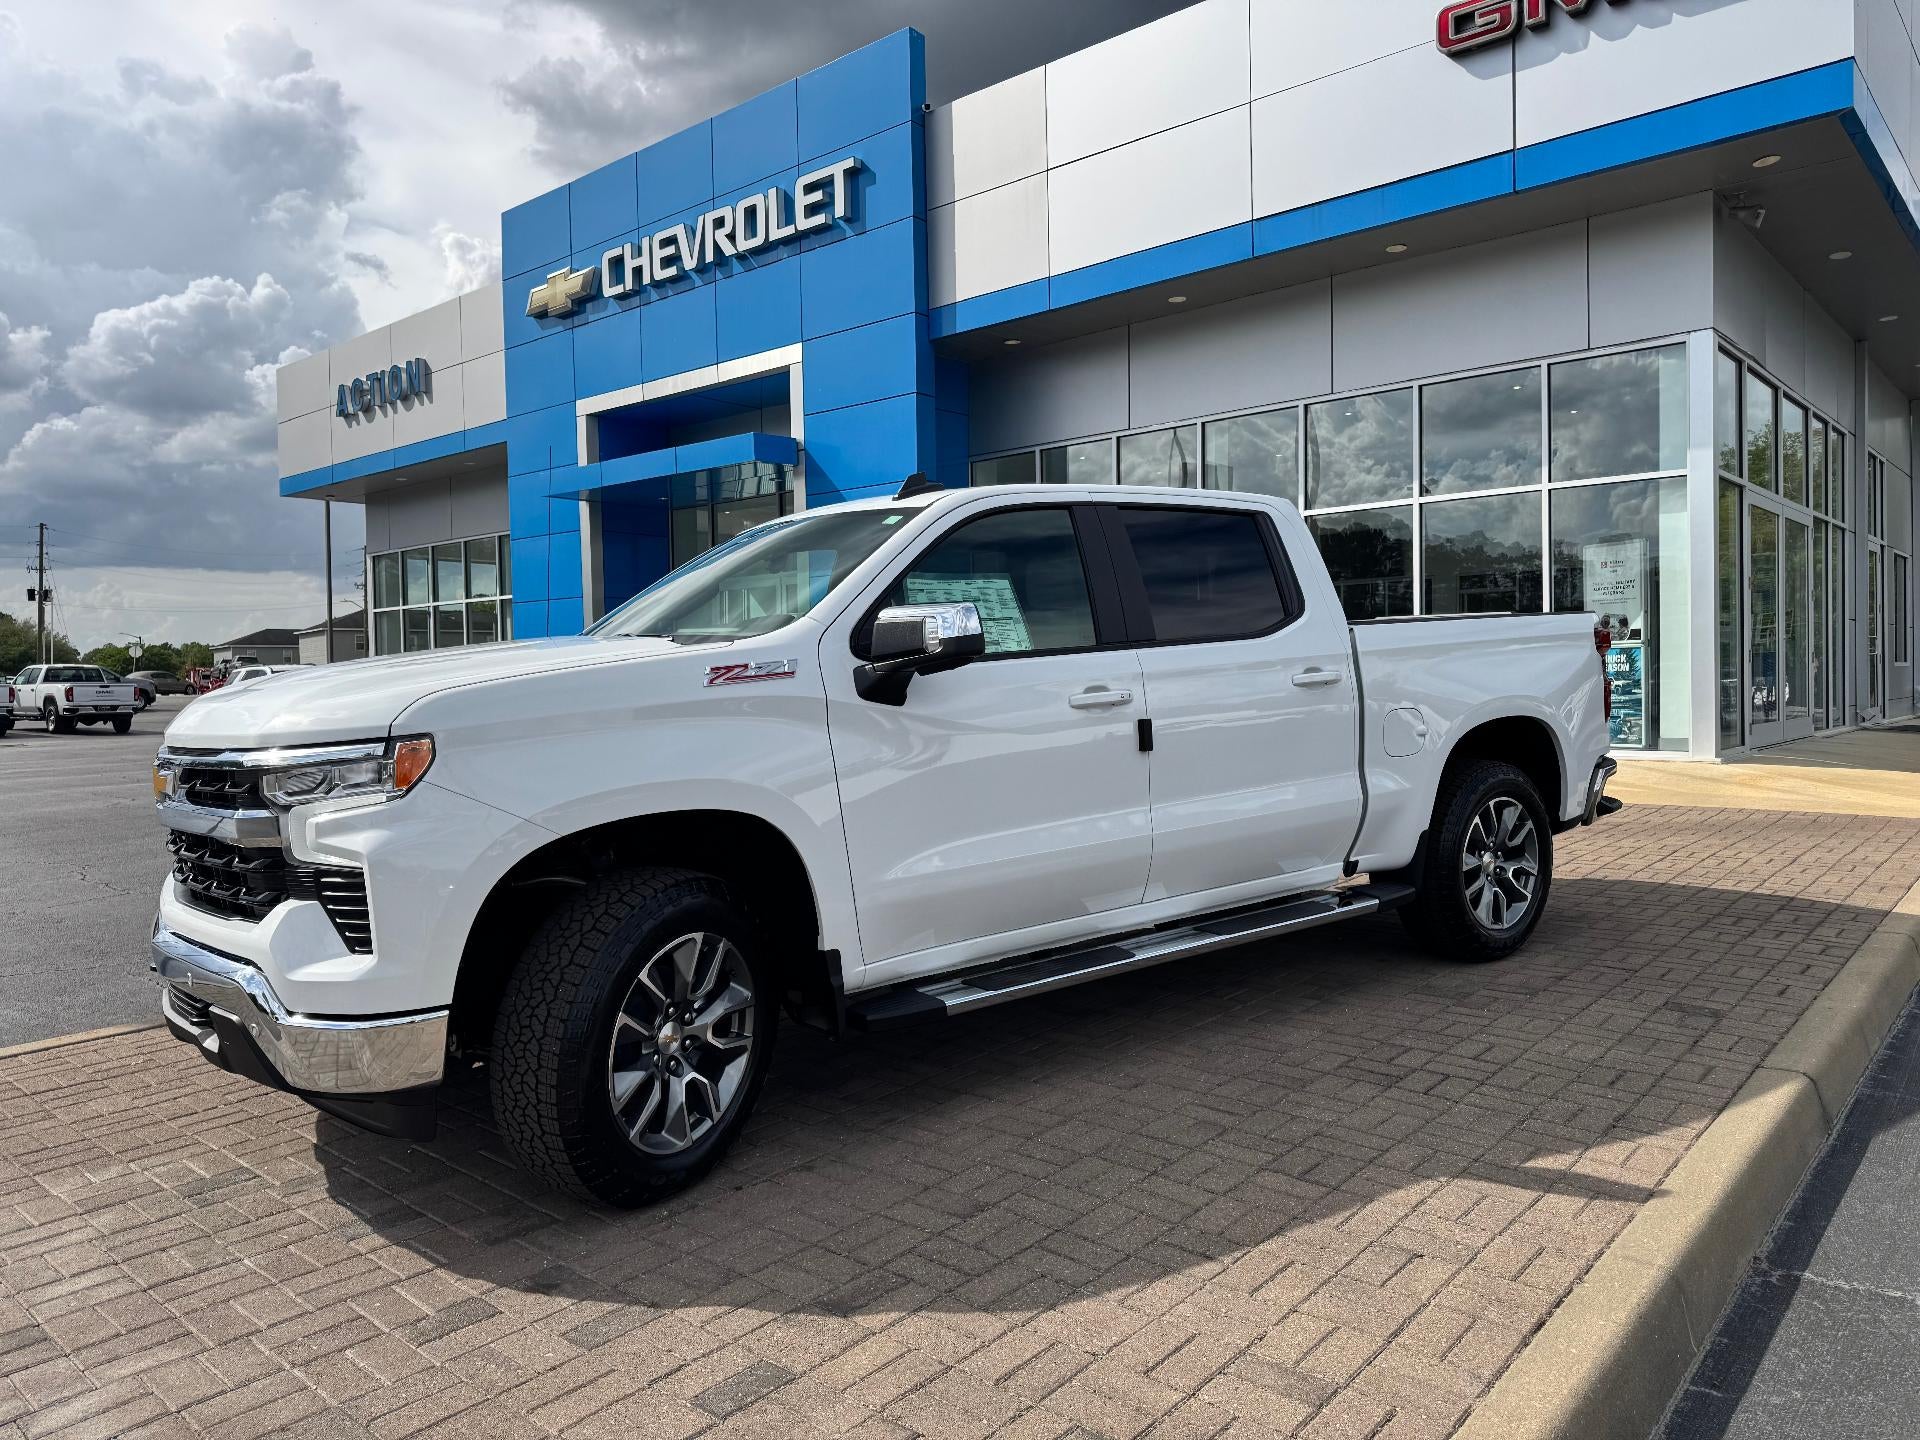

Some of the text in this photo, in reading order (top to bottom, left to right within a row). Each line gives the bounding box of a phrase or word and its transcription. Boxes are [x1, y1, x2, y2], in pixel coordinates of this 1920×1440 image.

[601, 156, 862, 298] CHEVROLET
[336, 357, 427, 418] ACTION
[1605, 654, 1627, 663] RUCK
